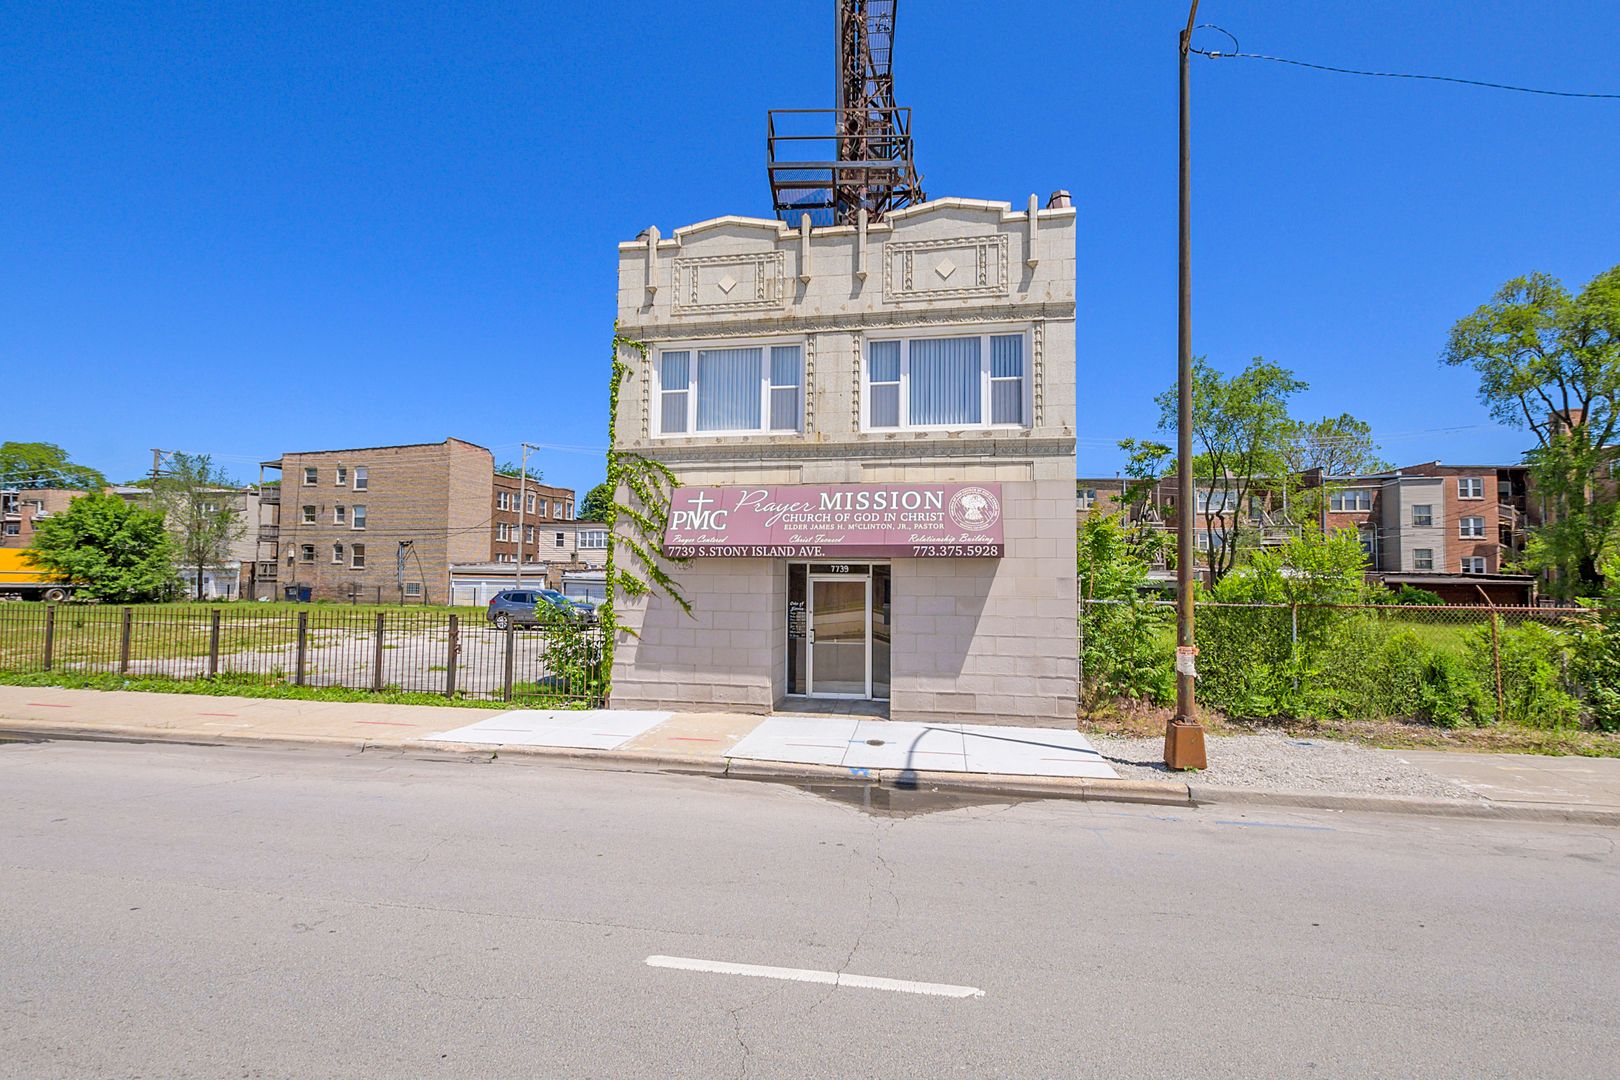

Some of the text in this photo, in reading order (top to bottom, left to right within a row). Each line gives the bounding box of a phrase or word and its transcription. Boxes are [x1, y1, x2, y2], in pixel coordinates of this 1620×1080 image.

[733, 490, 816, 528] Prayer
[818, 491, 944, 511] MISSION
[782, 512, 945, 522] CHURCH OF GOD IN CHRIST
[789, 534, 814, 543] Christ
[908, 533, 994, 544] Relationship Building
[668, 546, 695, 556] 7739
[752, 546, 795, 556] ISLAND
[799, 546, 825, 556] AVE.
[913, 545, 998, 556] 773.375.5928
[831, 565, 849, 573] 7739
